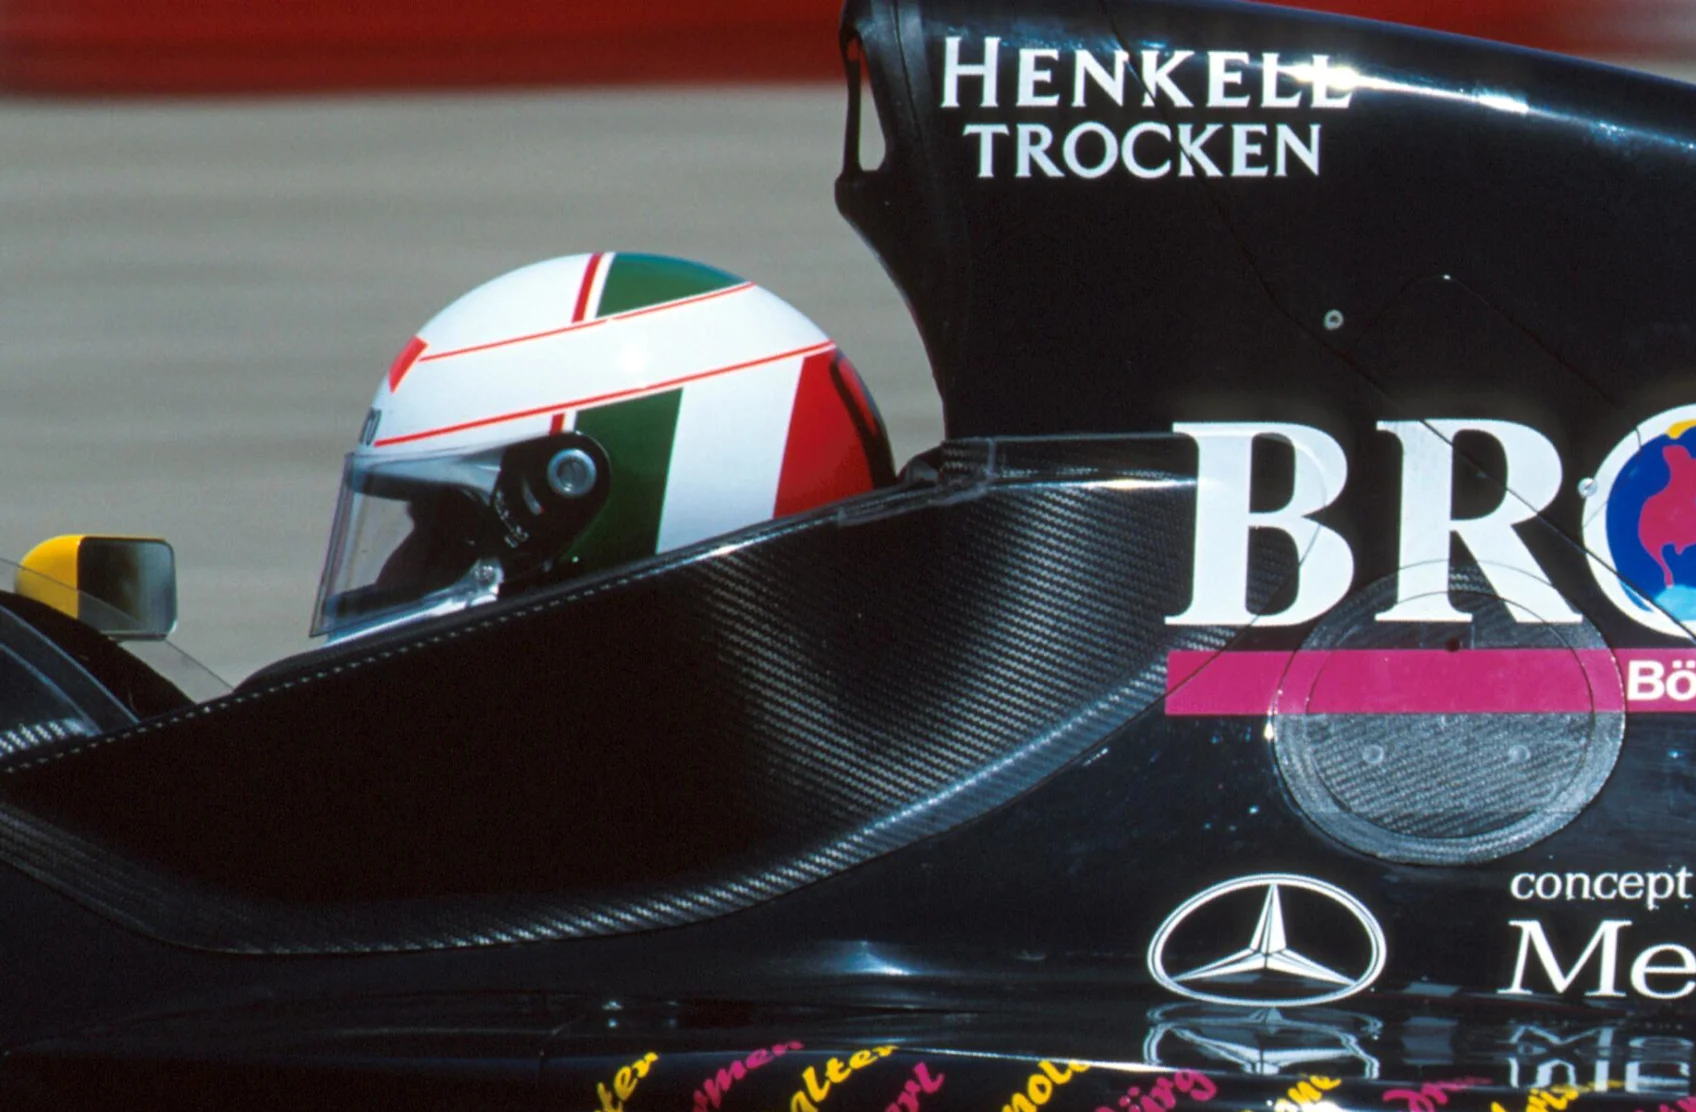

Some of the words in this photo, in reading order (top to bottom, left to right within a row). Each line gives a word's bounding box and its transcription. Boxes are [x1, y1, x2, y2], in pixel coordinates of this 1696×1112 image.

[940, 36, 1354, 109] HENKELL
[962, 121, 1322, 180] TROCKEN
[1510, 866, 1693, 910] concept
